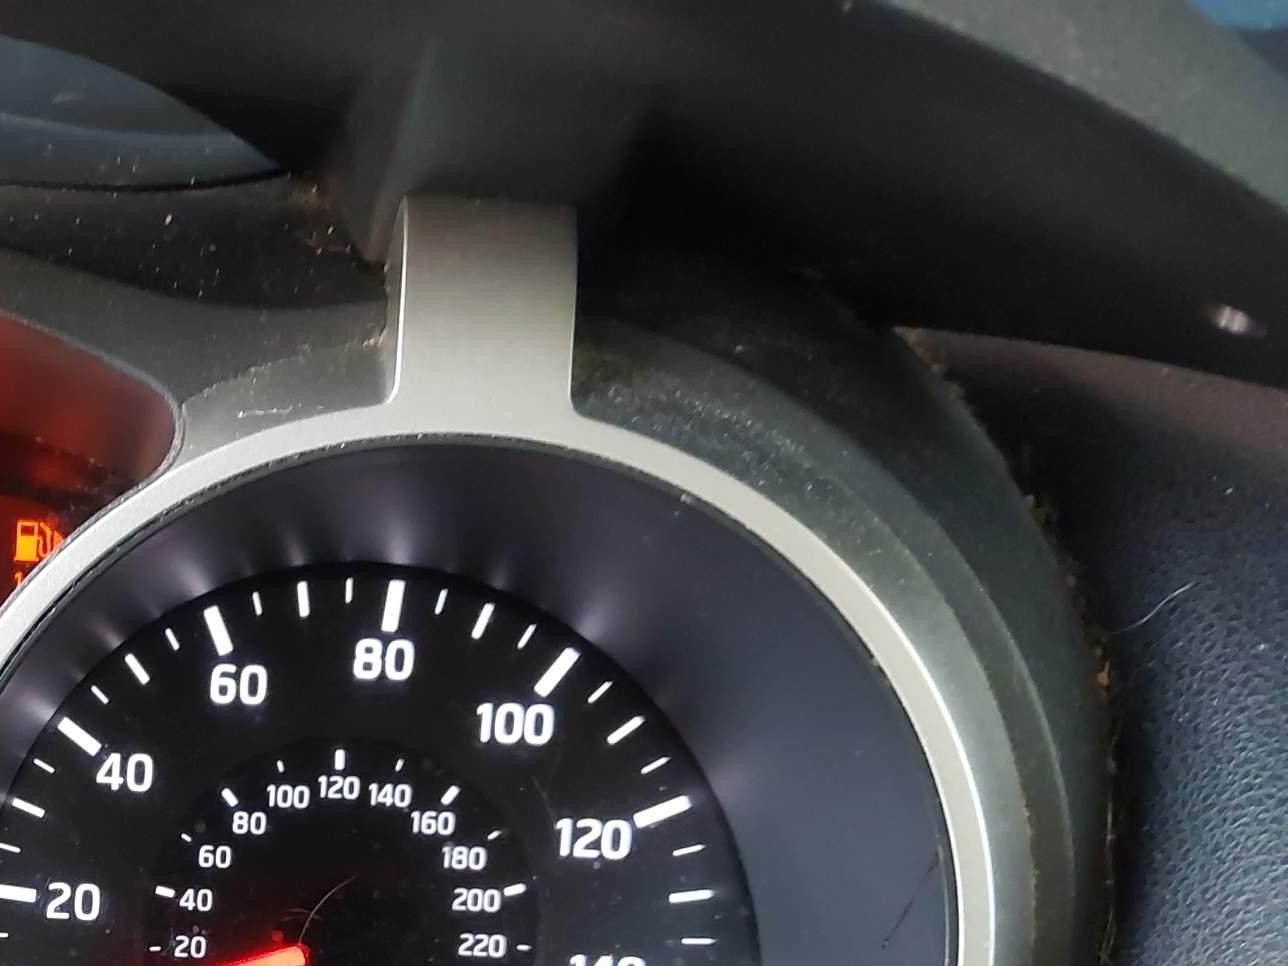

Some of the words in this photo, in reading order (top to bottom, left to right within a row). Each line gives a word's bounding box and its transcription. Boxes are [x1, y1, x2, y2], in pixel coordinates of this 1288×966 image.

[352, 638, 414, 681] 80
[209, 664, 268, 705] 60
[476, 702, 555, 745] 100
[96, 752, 153, 793] 40
[267, 785, 310, 809] 100
[318, 775, 360, 800] 120
[369, 783, 412, 808] 140
[232, 811, 267, 835] 80
[411, 811, 456, 836] 160
[555, 818, 632, 859] 120
[198, 845, 231, 869] 60
[442, 846, 487, 870] 180
[46, 882, 101, 921] 20
[179, 888, 213, 912] 40
[452, 888, 501, 912] 200
[174, 935, 207, 959] 20
[458, 933, 506, 958] 220
